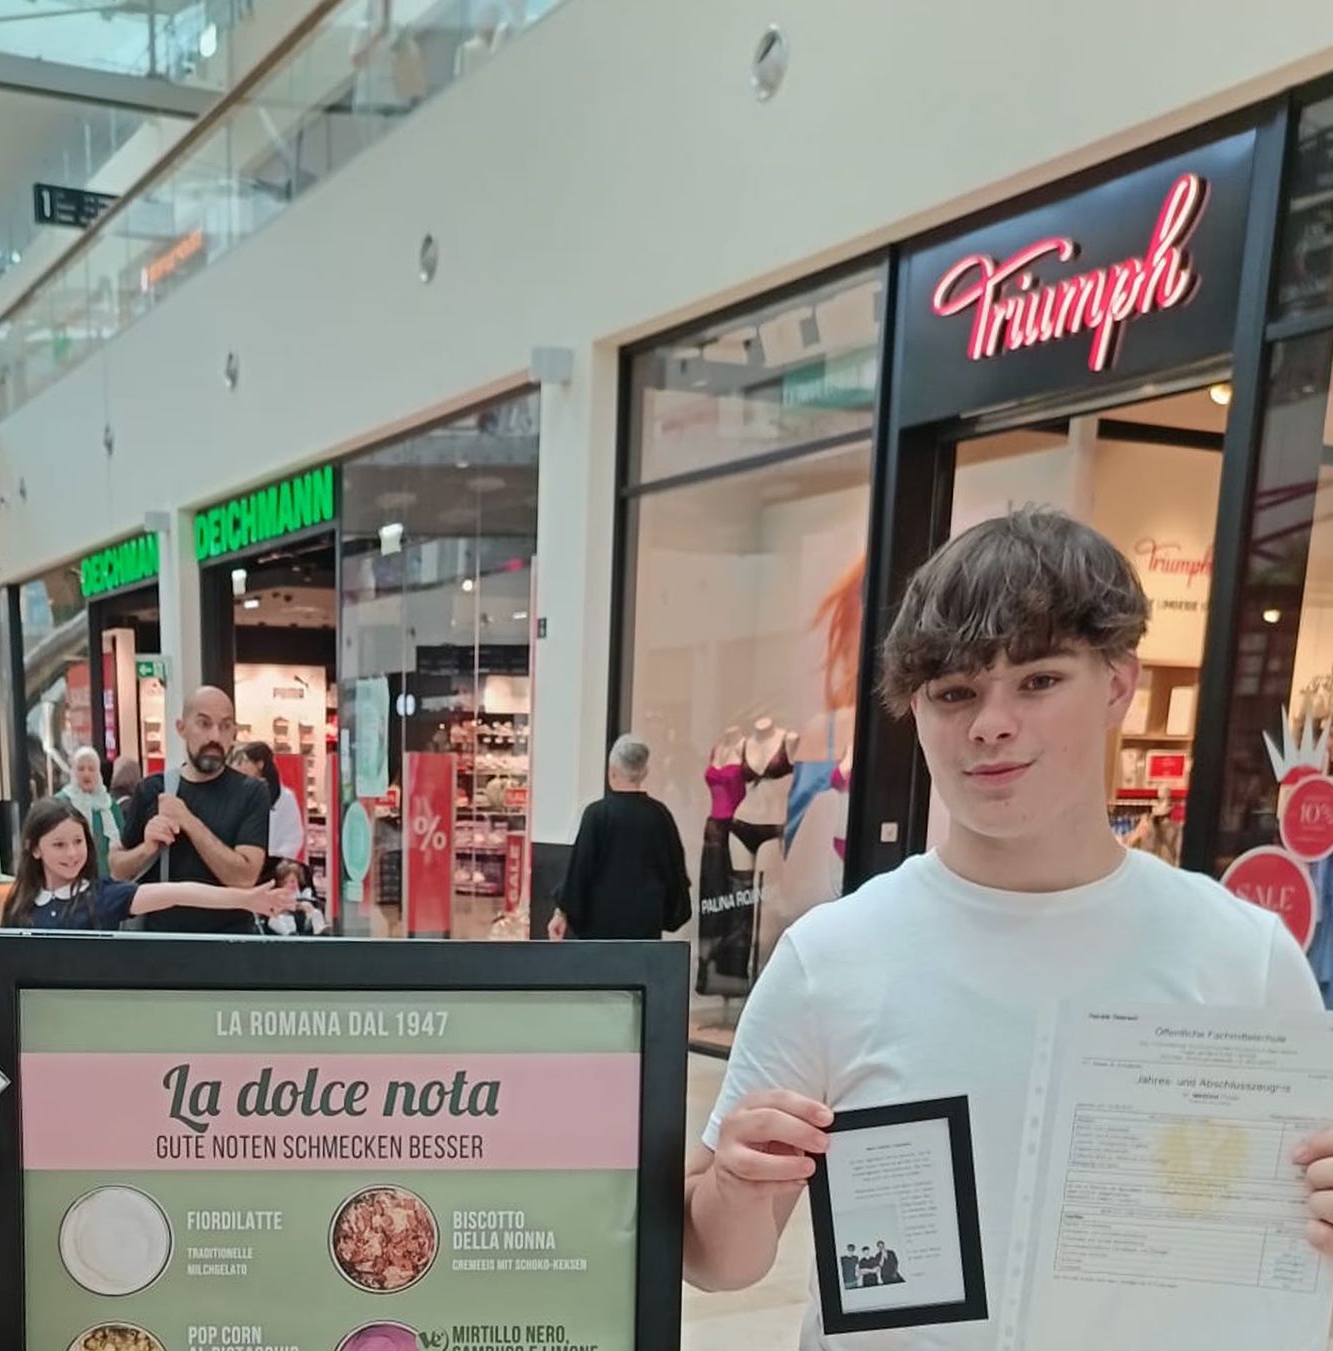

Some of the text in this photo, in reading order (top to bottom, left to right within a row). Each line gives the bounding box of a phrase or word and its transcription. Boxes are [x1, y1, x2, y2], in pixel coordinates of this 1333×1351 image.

[931, 172, 1207, 372] Triumph
[196, 465, 332, 561] DEICHMANN
[217, 1010, 449, 1037] LA ROMANA DAL 1947
[162, 1063, 501, 1134] La dolce nota
[156, 1135, 483, 1159] GUTE NOTEN SCHMECKEN BESSER
[187, 1211, 282, 1231] FIORDILATTE
[453, 1211, 525, 1230] BISCOTTO
[453, 1231, 556, 1250] DELLA NONNA
[187, 1247, 253, 1259] TRADITIONELLE
[187, 1263, 247, 1275] MILCHGELATO
[188, 1326, 262, 1344] POP CORN
[452, 1325, 570, 1346] MIRTILLO NERO,
